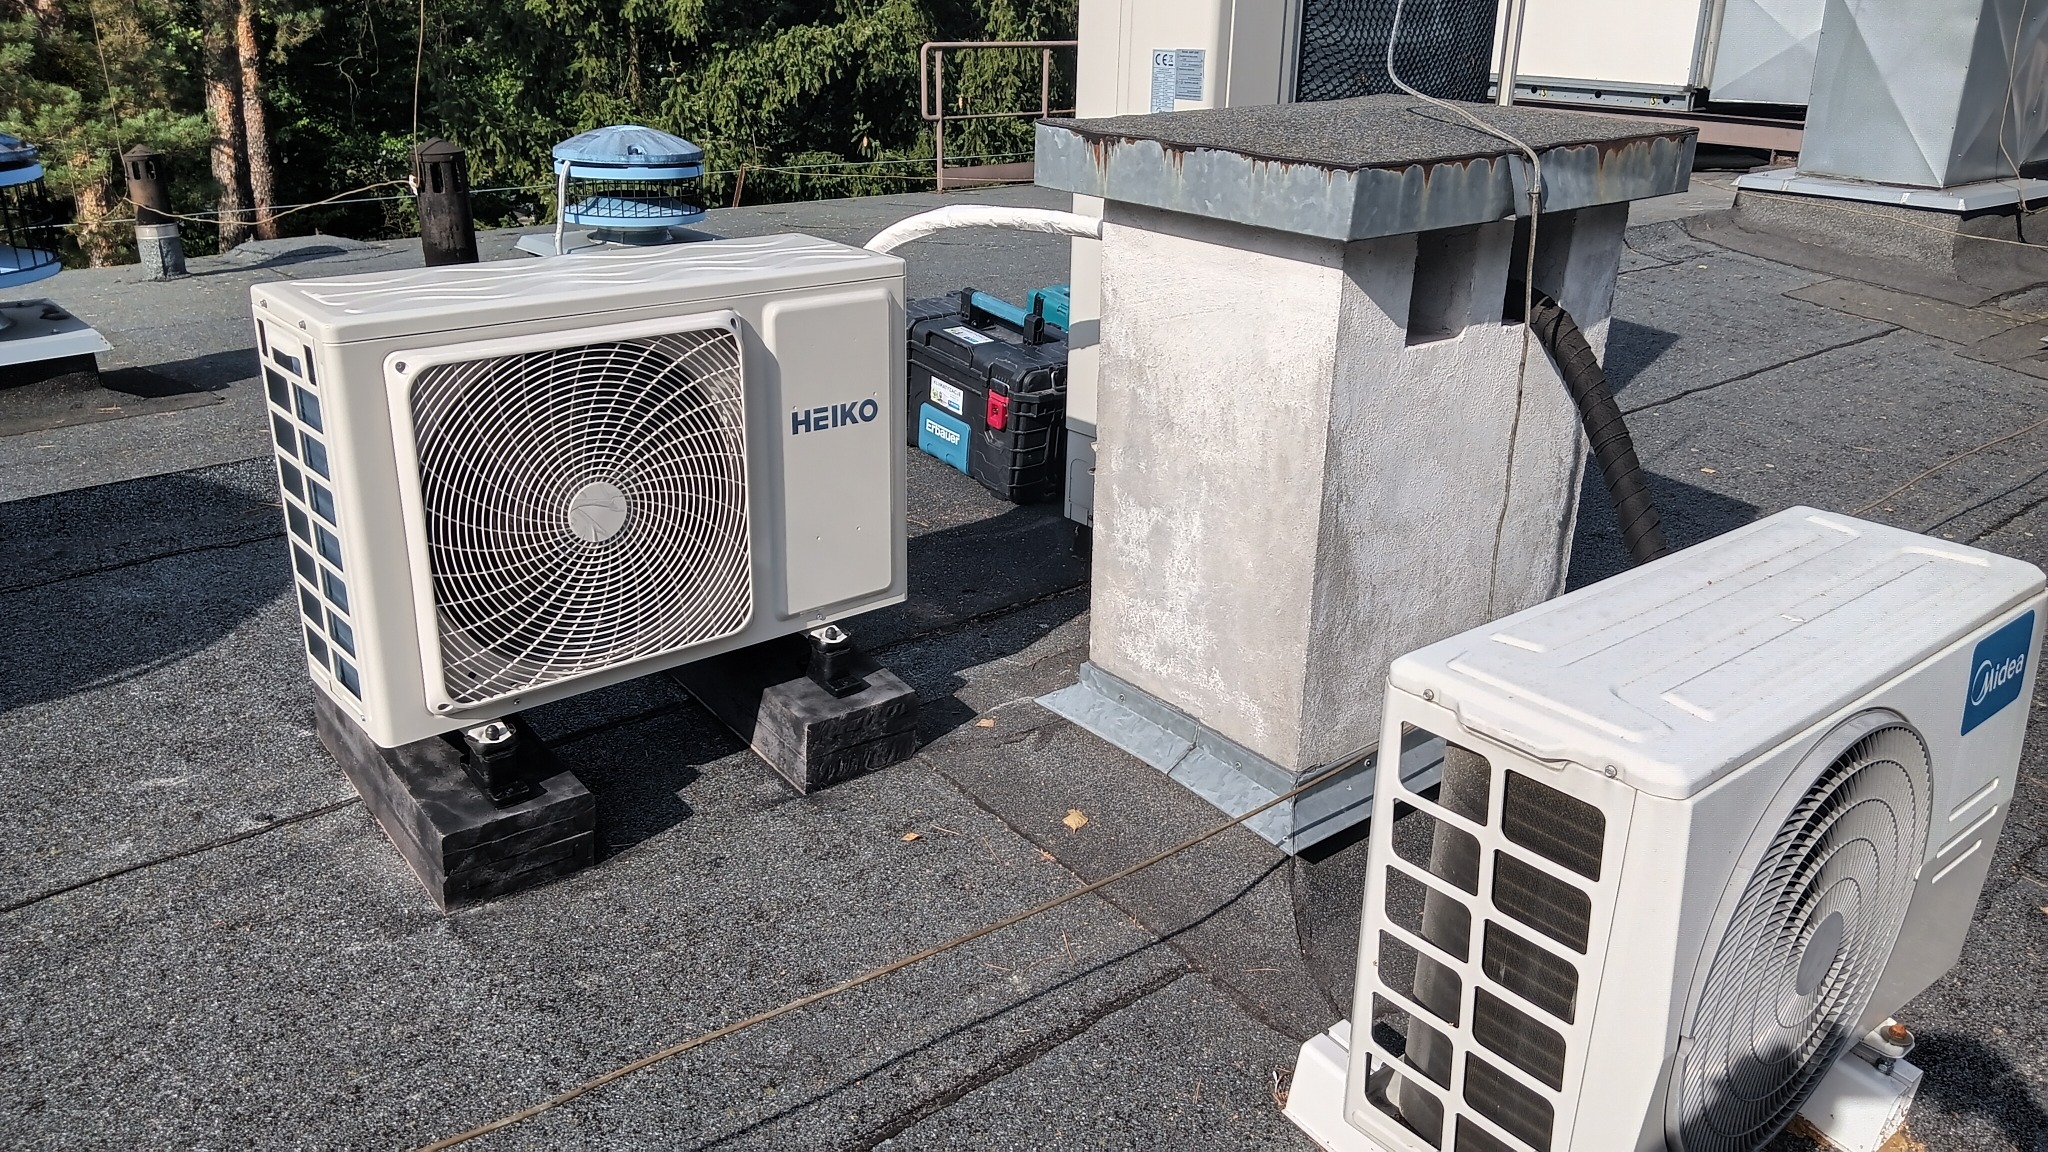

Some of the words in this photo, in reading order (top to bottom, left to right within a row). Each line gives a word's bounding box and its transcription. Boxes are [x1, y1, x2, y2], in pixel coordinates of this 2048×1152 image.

[1155, 53, 1168, 66] CE
[791, 398, 879, 436] HEIKO
[925, 418, 960, 446] Erbauer
[1970, 653, 2025, 706] Midea
